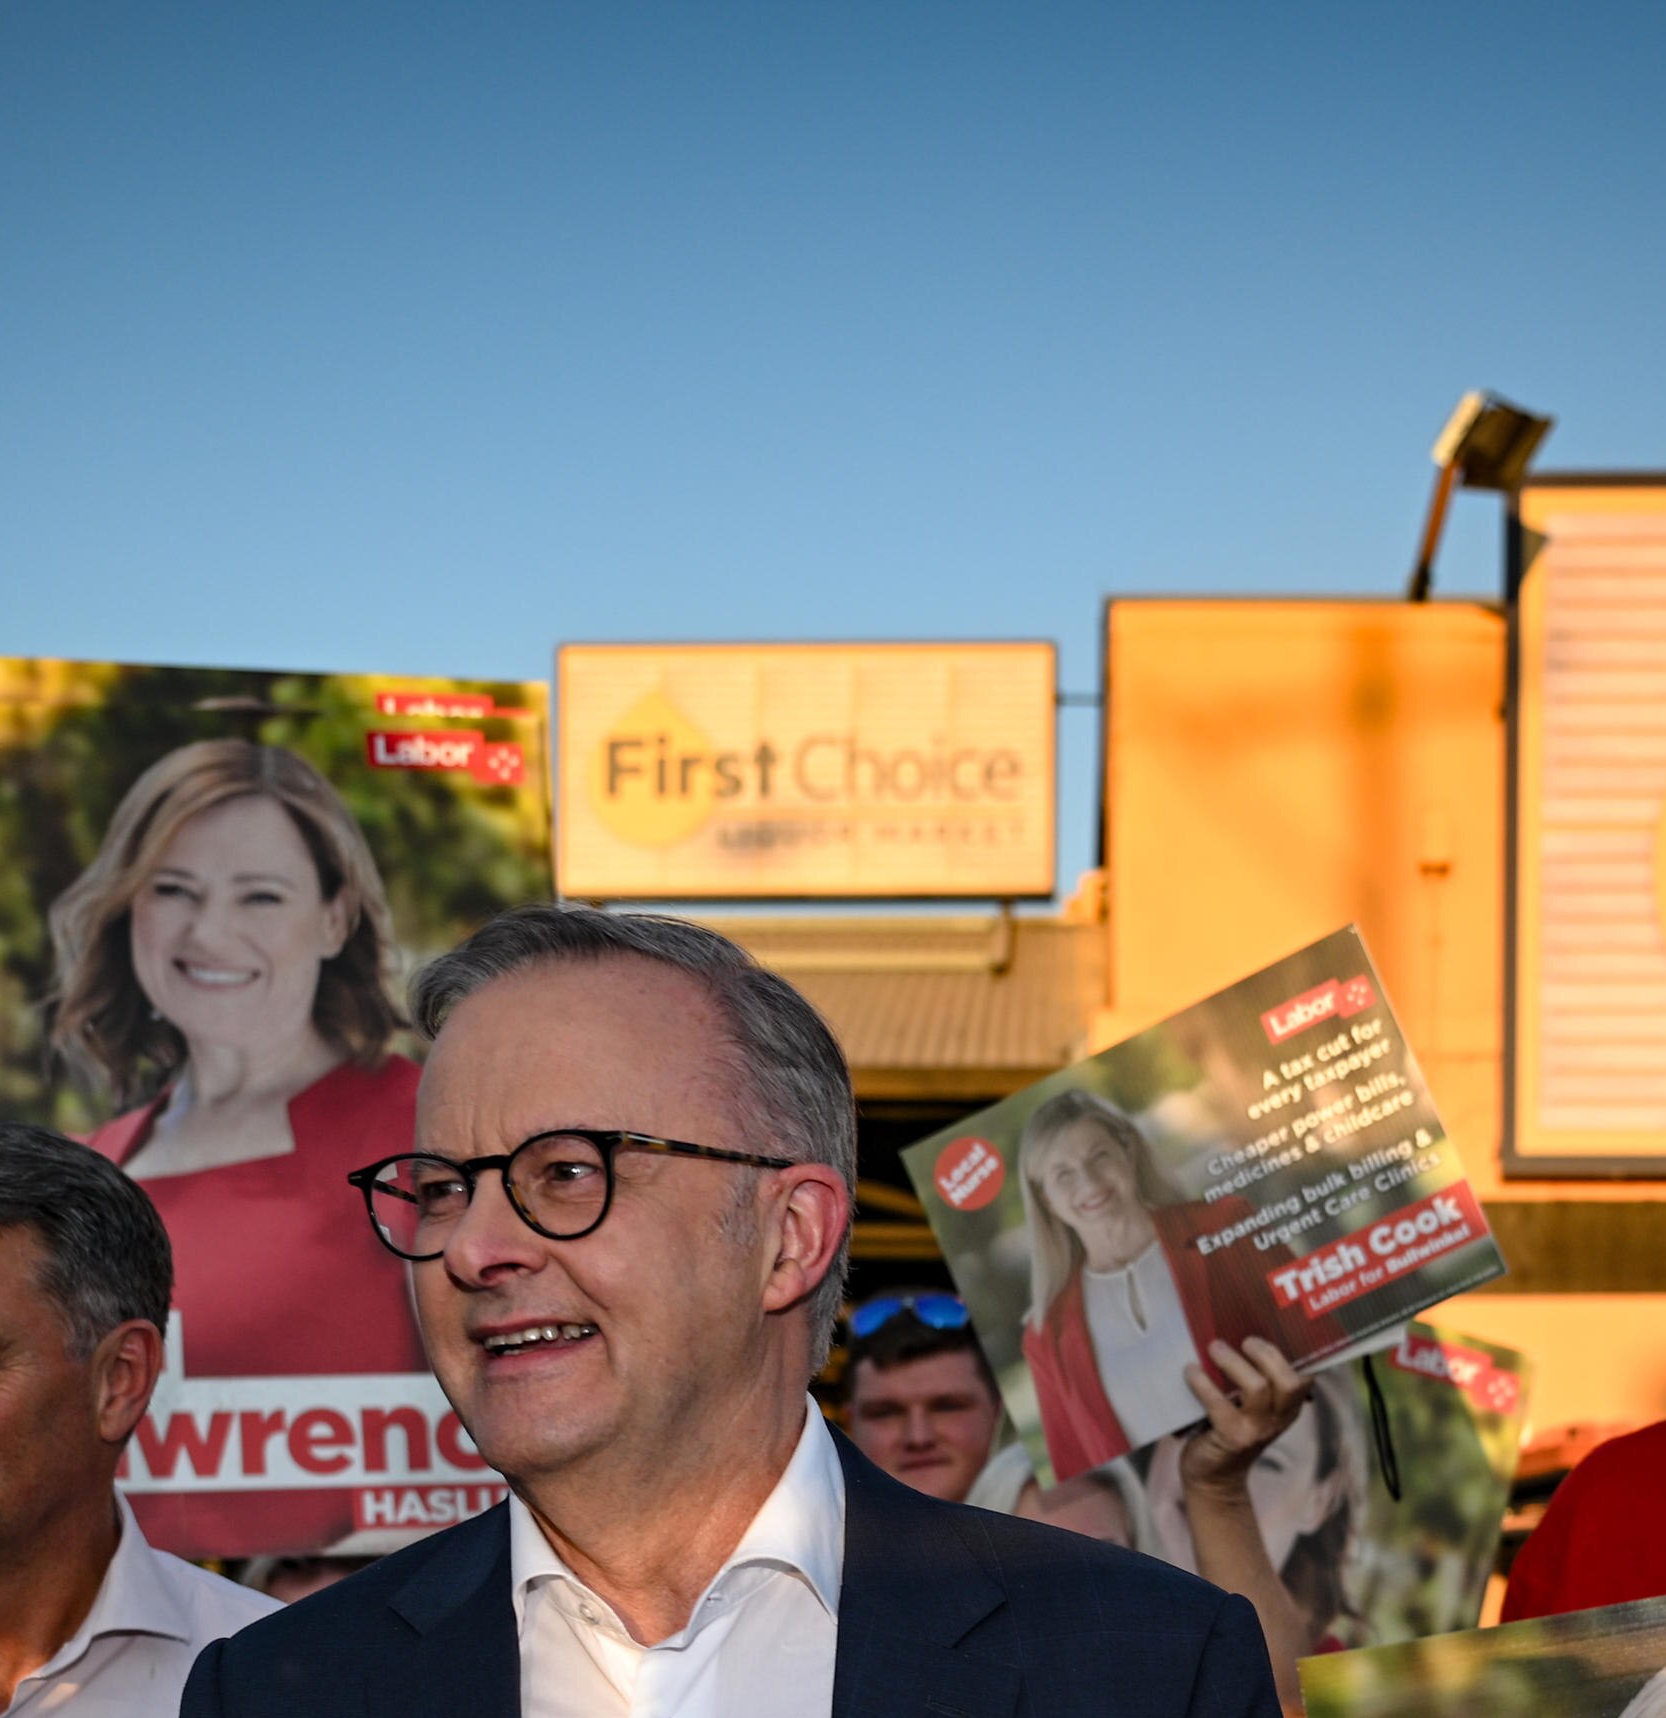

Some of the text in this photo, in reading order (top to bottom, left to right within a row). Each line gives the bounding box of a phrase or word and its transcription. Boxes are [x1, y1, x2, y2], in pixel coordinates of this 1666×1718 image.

[373, 734, 475, 767] Labor
[606, 732, 1021, 801] First Choice
[1269, 991, 1335, 1037] Labor
[1247, 1038, 1390, 1120] every taxpayer
[1263, 1019, 1381, 1091] A tax cut for
[939, 1142, 987, 1191] Local
[1203, 1091, 1413, 1204] medicines & childcare
[1207, 1127, 1289, 1176] Cheaper
[1291, 1095, 1354, 1138] power
[950, 1156, 999, 1207] Nurse
[1196, 1128, 1432, 1256] Expanding bulk billing &
[1253, 1153, 1441, 1251] Urgent Care Clinics
[1273, 1195, 1464, 1300] Trish Cook
[1308, 1279, 1358, 1311] Labor
[1359, 1265, 1384, 1289] for
[1396, 1335, 1481, 1386] Labor
[115, 1404, 489, 1478] wrenc
